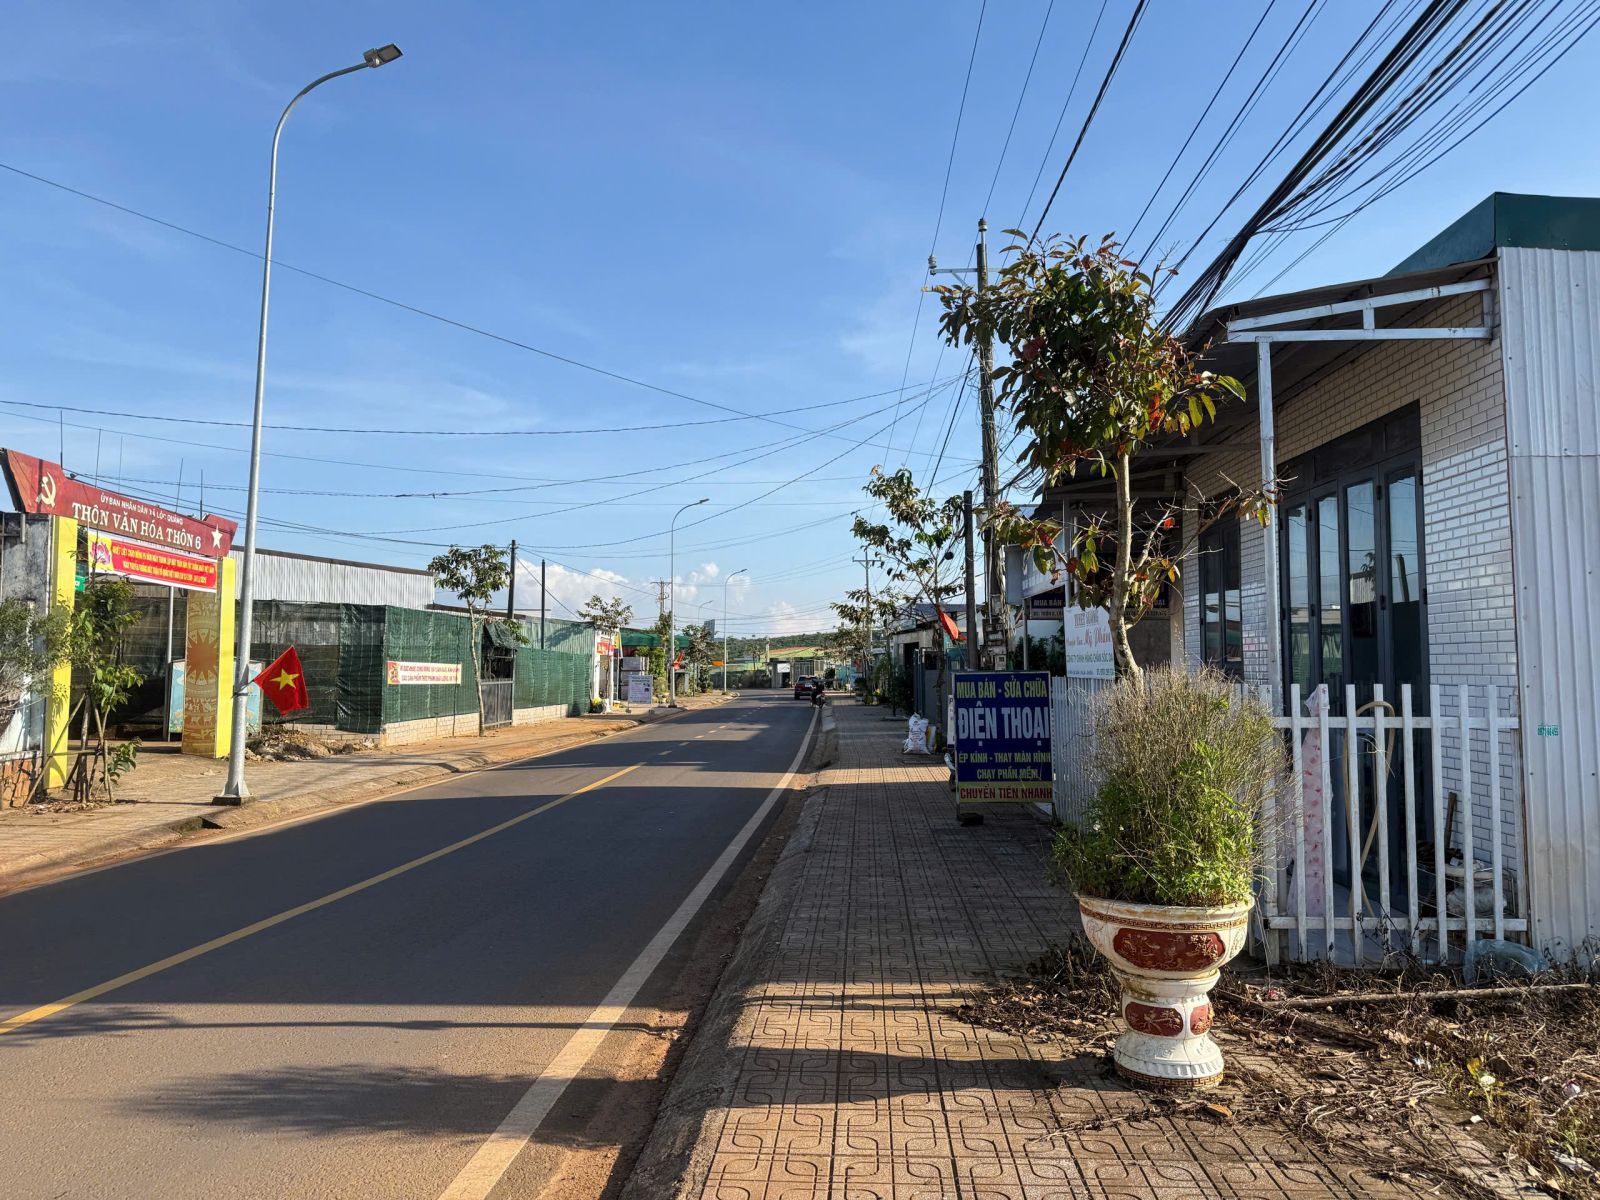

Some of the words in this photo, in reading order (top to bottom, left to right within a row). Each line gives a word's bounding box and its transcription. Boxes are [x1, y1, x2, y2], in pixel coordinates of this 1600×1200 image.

[72, 502, 108, 527] THÔN
[112, 509, 138, 534] VĂN
[140, 517, 164, 540] HÓA
[166, 523, 193, 547] THÔN
[194, 536, 202, 550] 6
[957, 682, 976, 698] MUA
[978, 677, 996, 698] BÁN
[1004, 675, 1022, 698] SỬA
[1024, 677, 1047, 698] CHỮA
[957, 701, 997, 746] ĐIỆN
[1001, 706, 1049, 746] THOẠI
[959, 752, 968, 763] ÉP
[970, 752, 987, 763] KÍNH
[994, 753, 1012, 763] THAY
[1014, 752, 1031, 763] MÀN
[1033, 752, 1050, 763] HÌNH
[977, 769, 995, 781] CHẠY
[960, 784, 995, 799] CHUYỂN
[1022, 788, 1052, 799] NHANH
